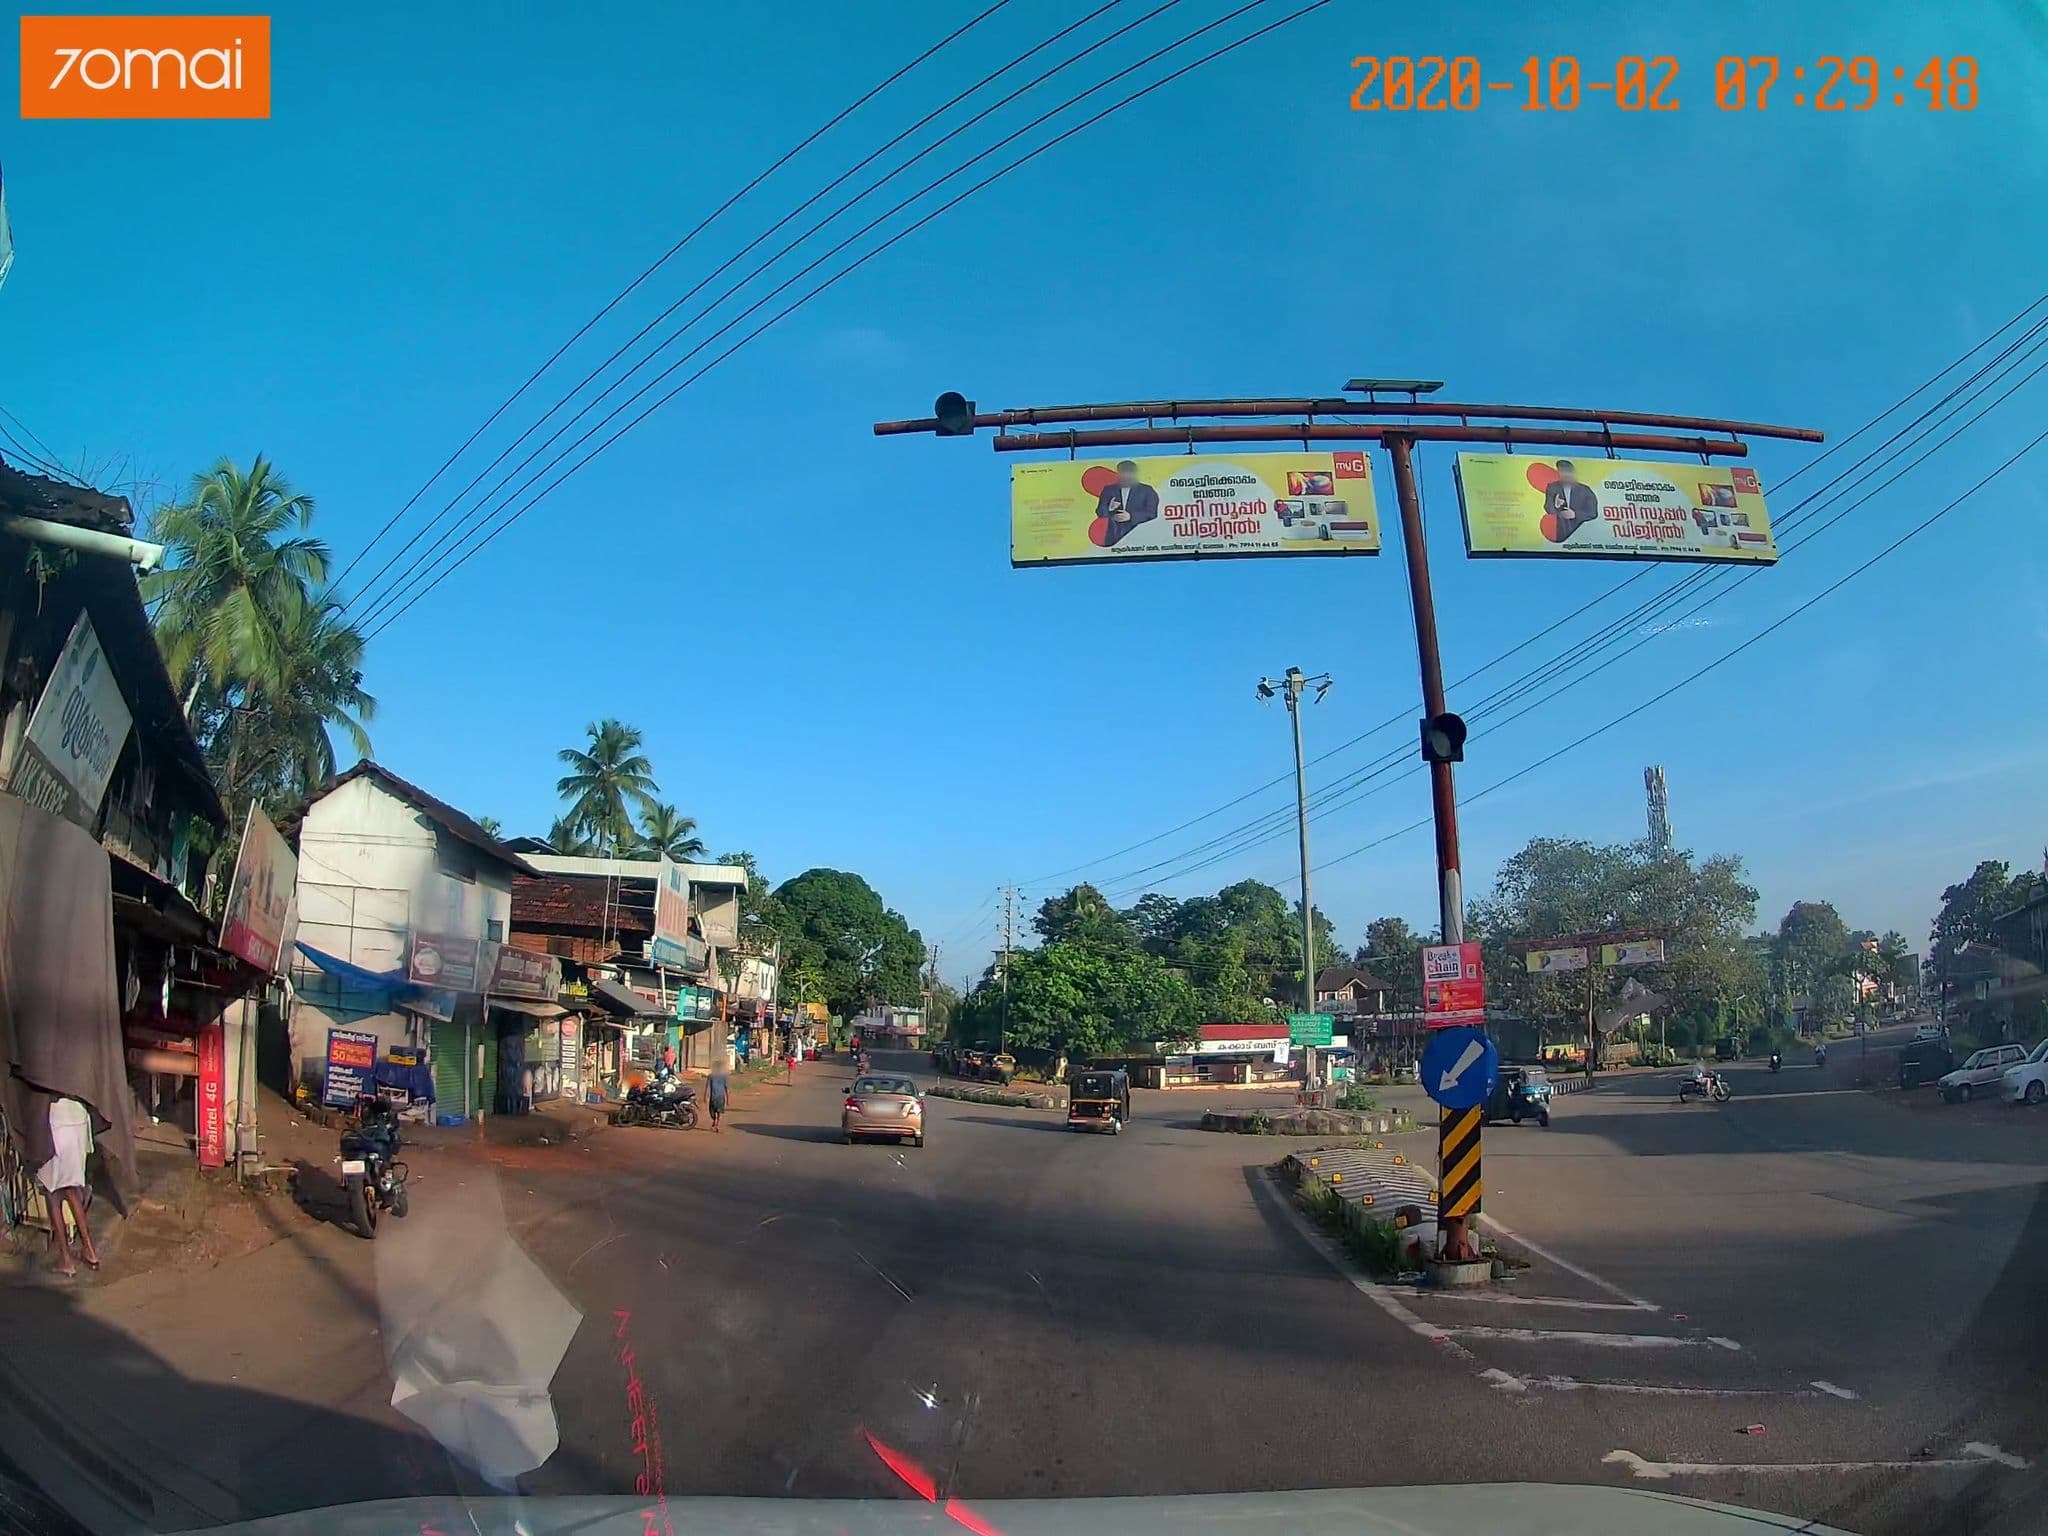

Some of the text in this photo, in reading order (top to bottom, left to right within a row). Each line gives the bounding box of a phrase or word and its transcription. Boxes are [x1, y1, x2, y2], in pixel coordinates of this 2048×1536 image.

[1164, 499, 1204, 520] ഇനി
[1603, 503, 1638, 521] ഇനി
[206, 1082, 217, 1102] 4G
[206, 1107, 218, 1143] airtel
